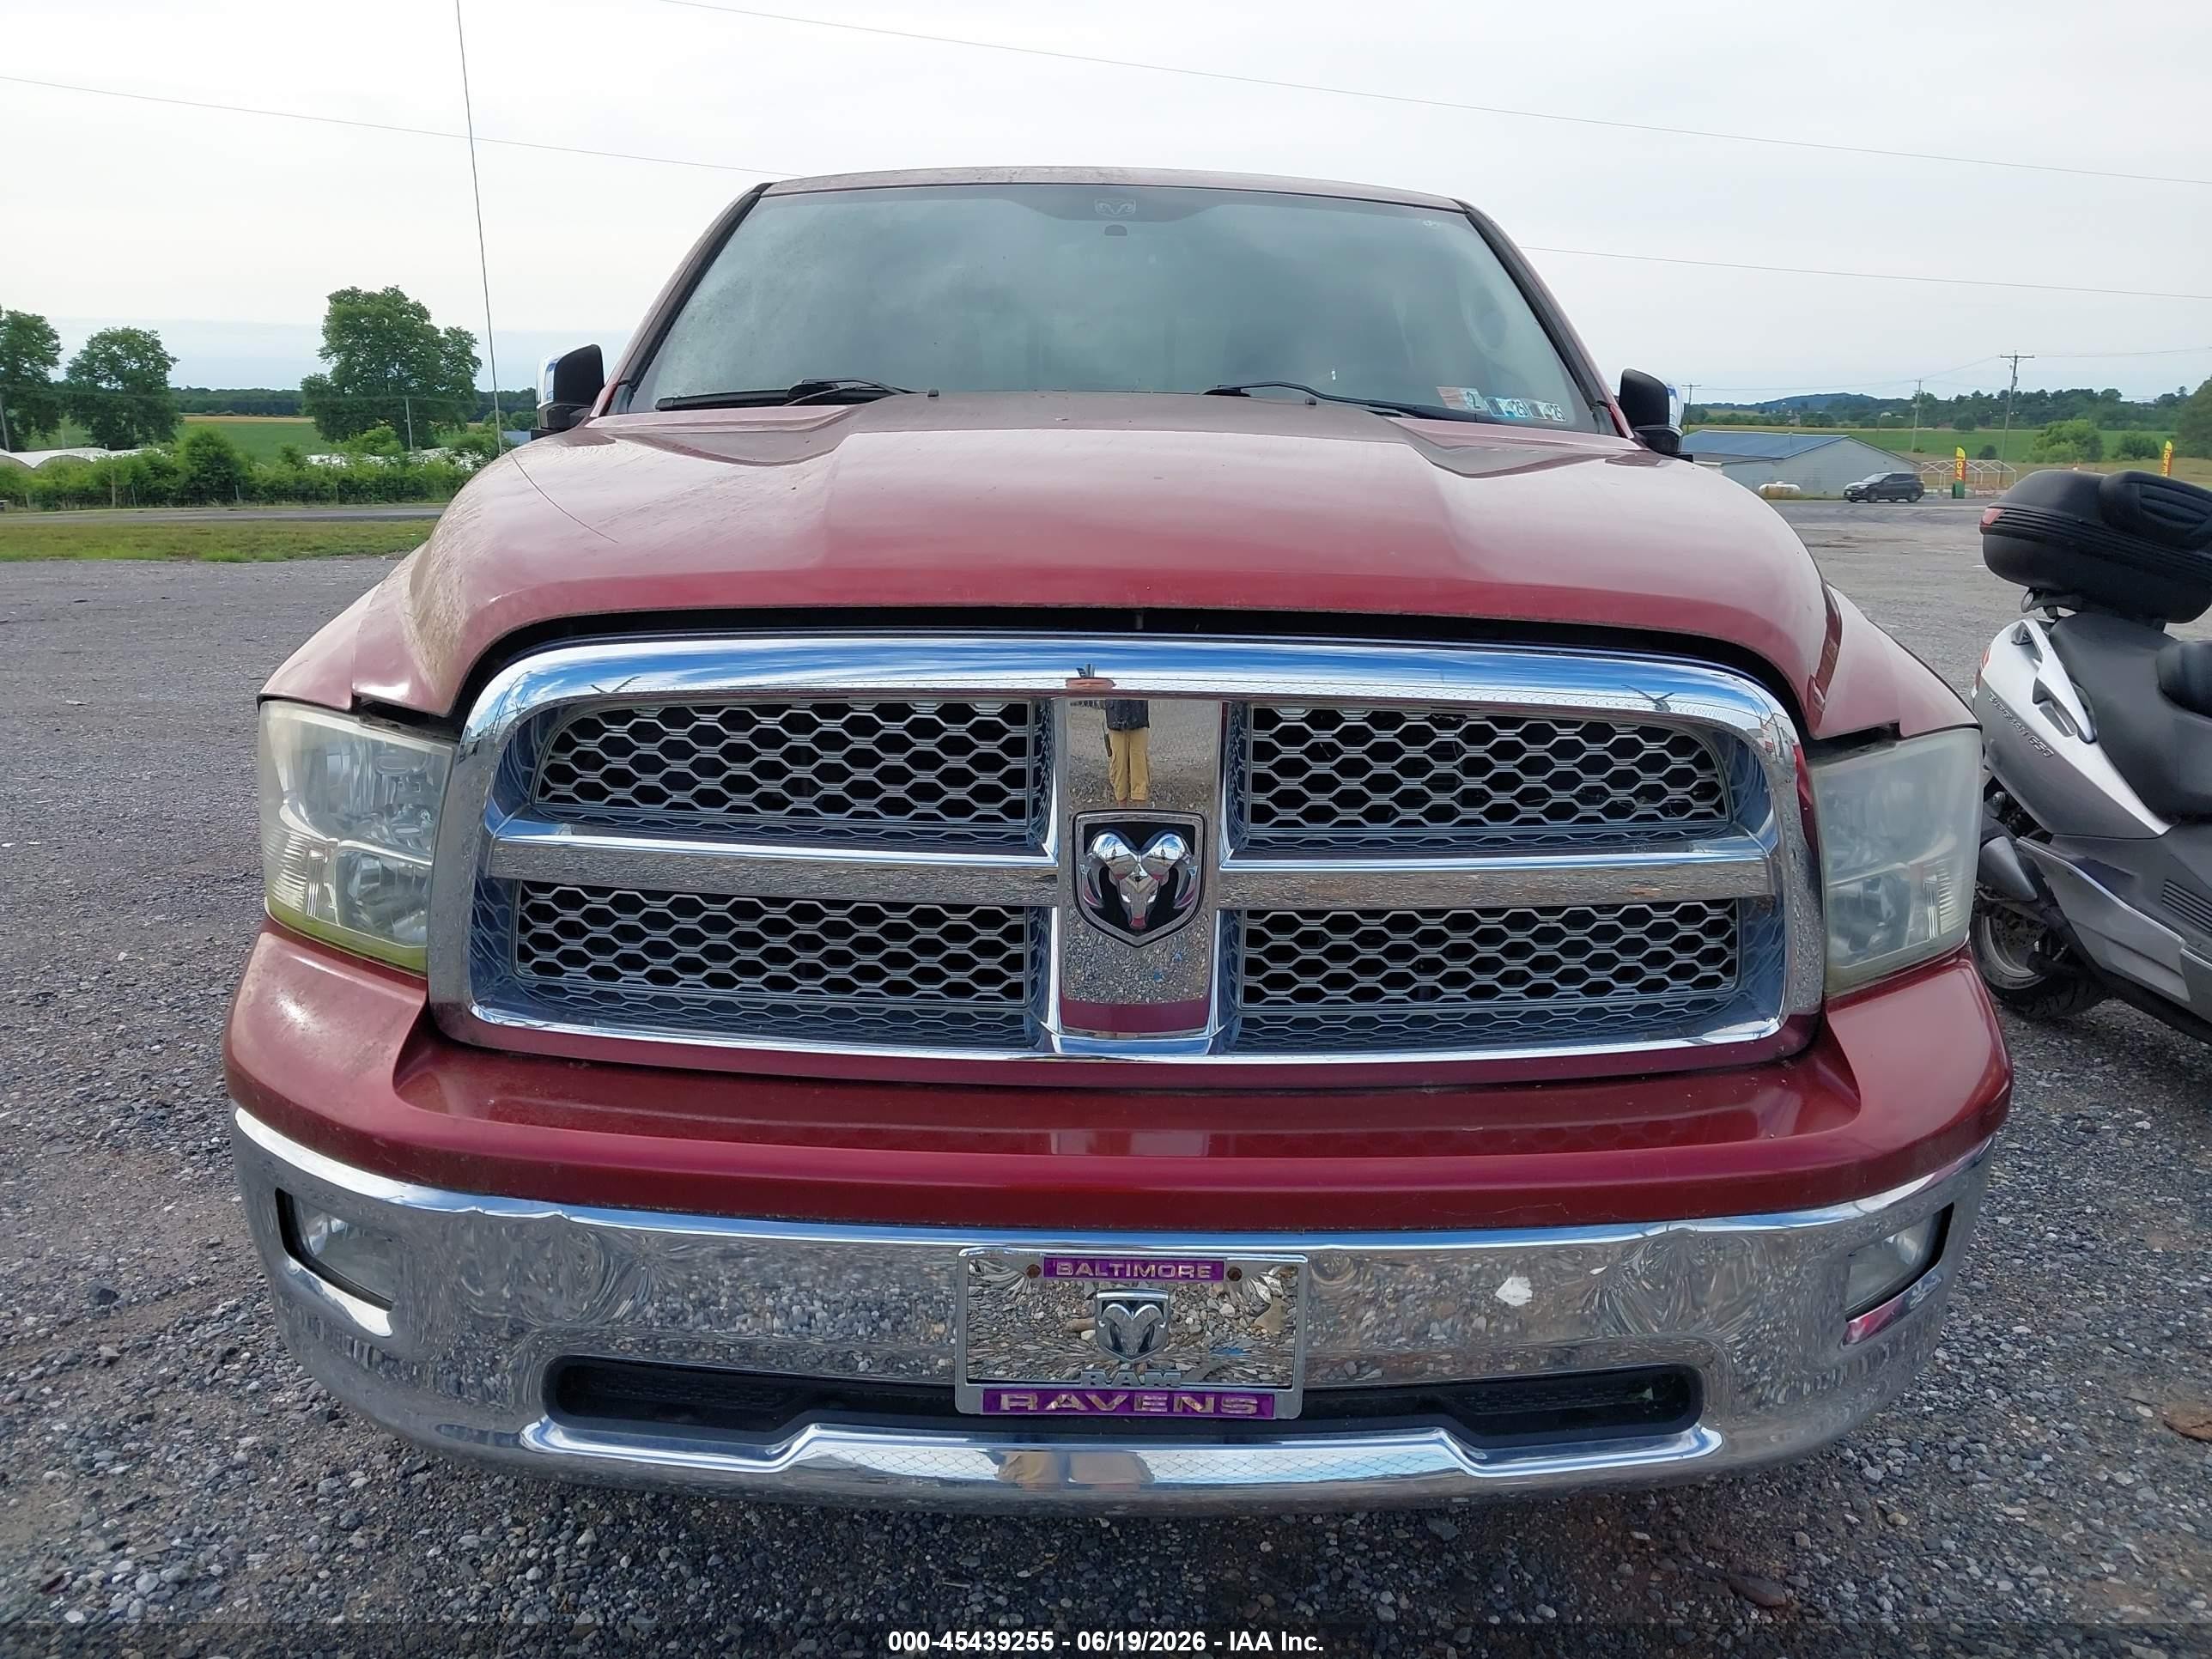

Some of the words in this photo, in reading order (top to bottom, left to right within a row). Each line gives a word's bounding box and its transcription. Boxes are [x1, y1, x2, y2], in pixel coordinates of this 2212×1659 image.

[2028, 735, 2054, 757] 650
[1055, 1261, 1212, 1279] BALTIMORE
[1080, 1369, 1182, 1388] RAM
[999, 1392, 1259, 1415] RAVENS
